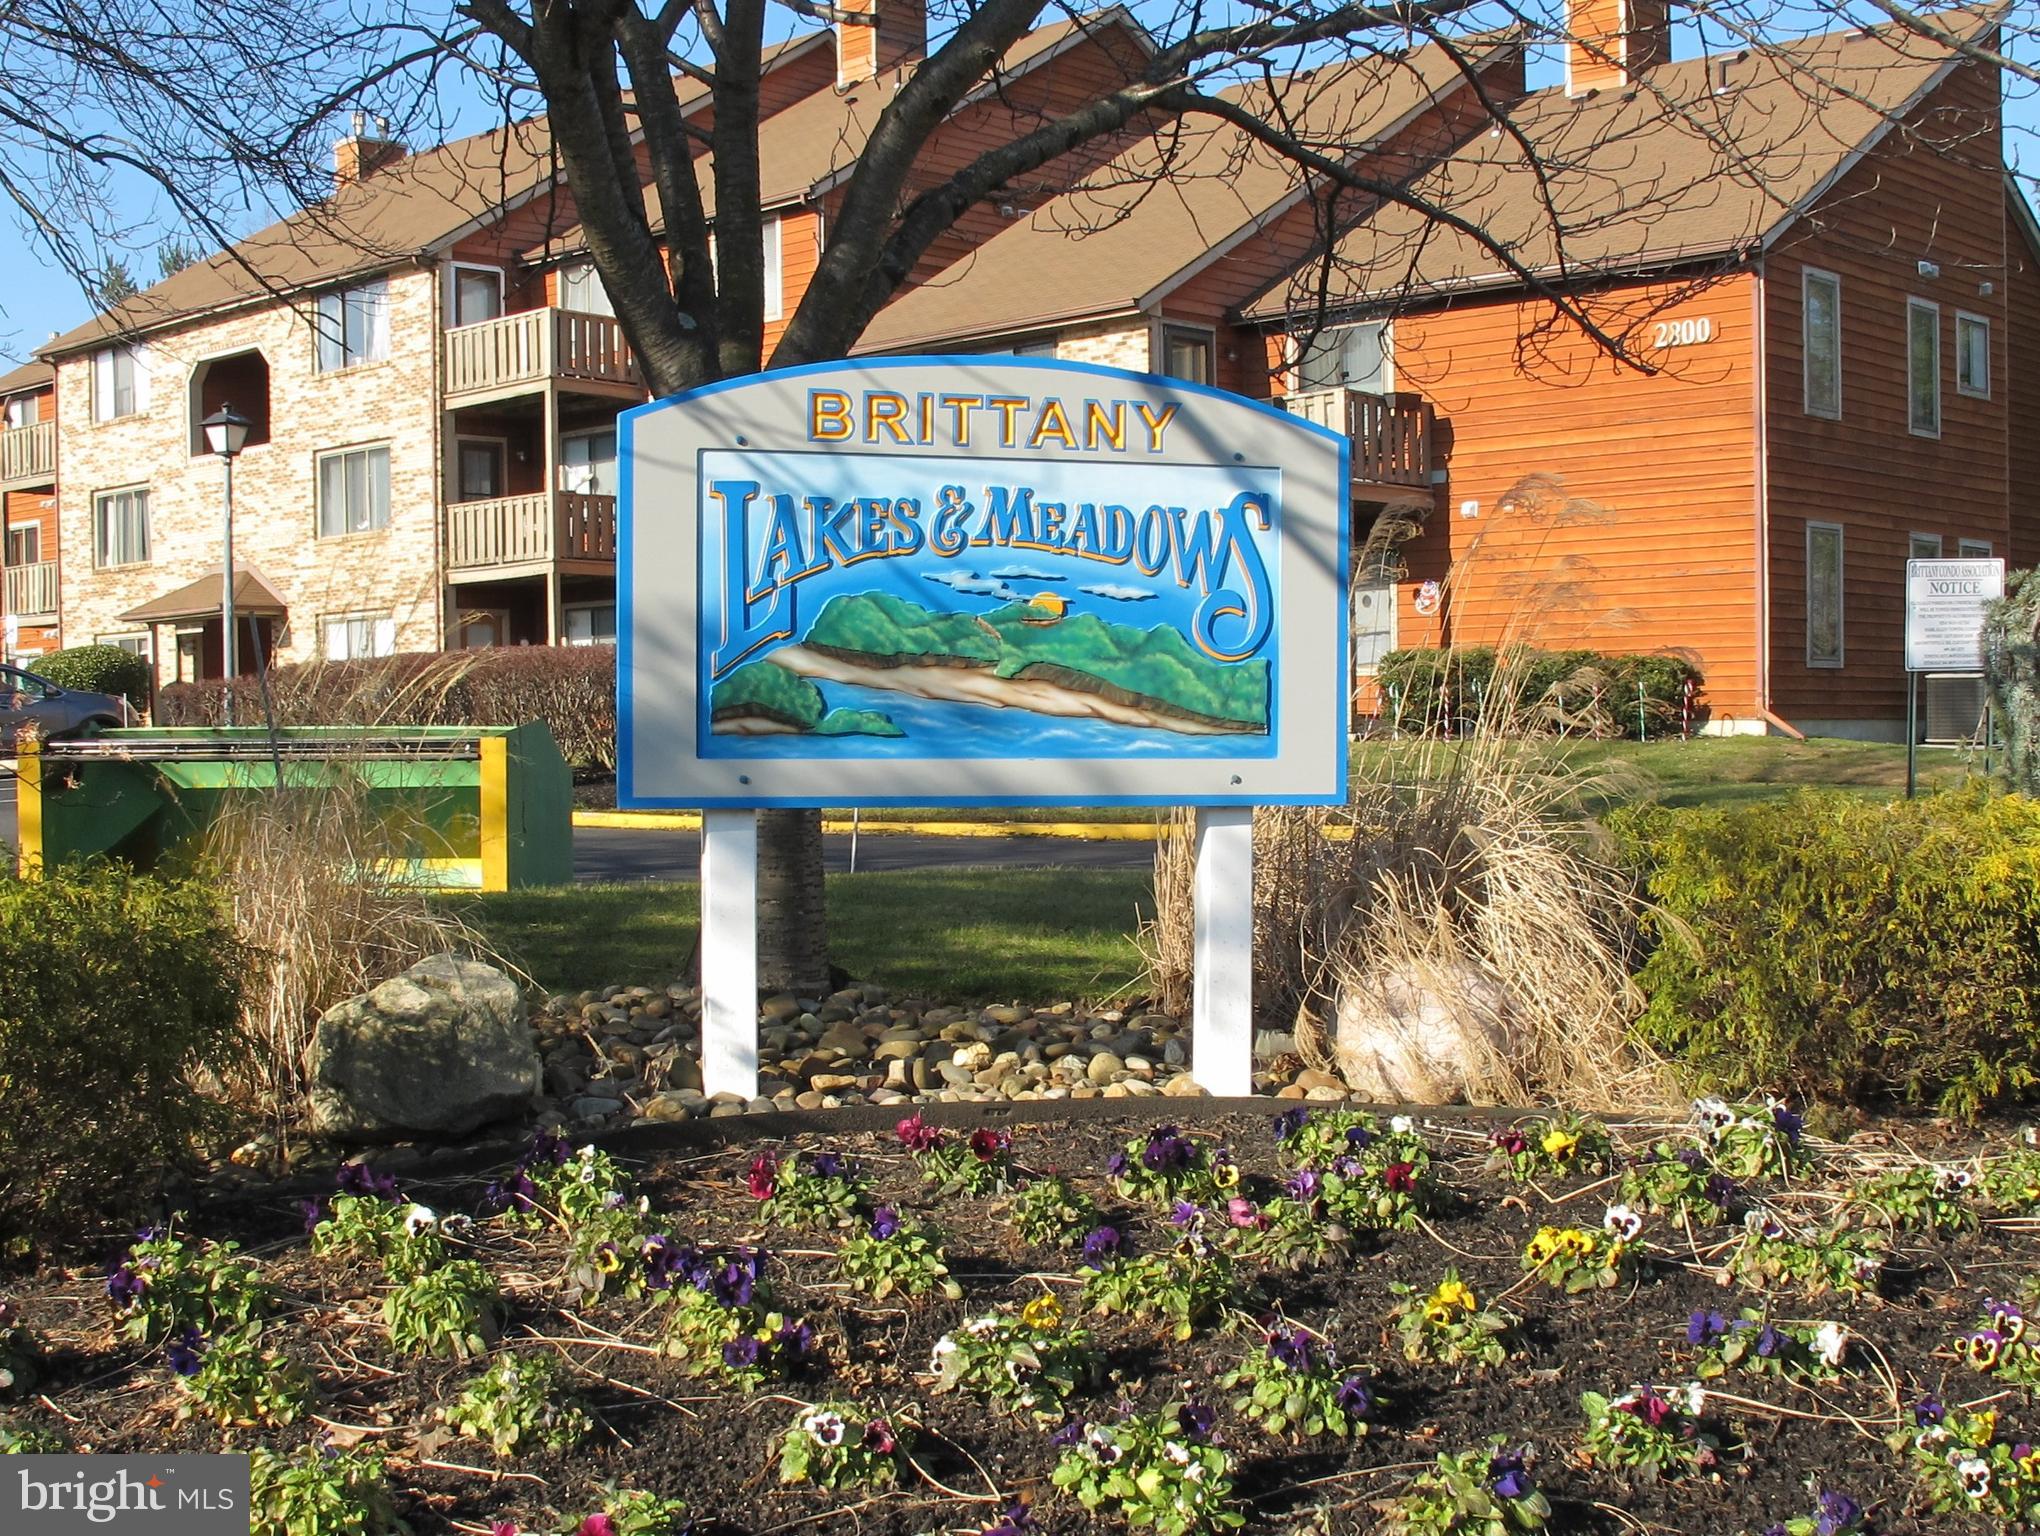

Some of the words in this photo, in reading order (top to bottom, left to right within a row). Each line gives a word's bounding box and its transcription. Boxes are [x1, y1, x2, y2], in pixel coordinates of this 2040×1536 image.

[1654, 317, 1711, 349] 2800
[807, 387, 1182, 454] BRITTANY
[709, 480, 923, 678] LAKES
[928, 484, 971, 558] &
[971, 485, 1273, 664] MEADOWS
[1929, 581, 1981, 594] NOTICE
